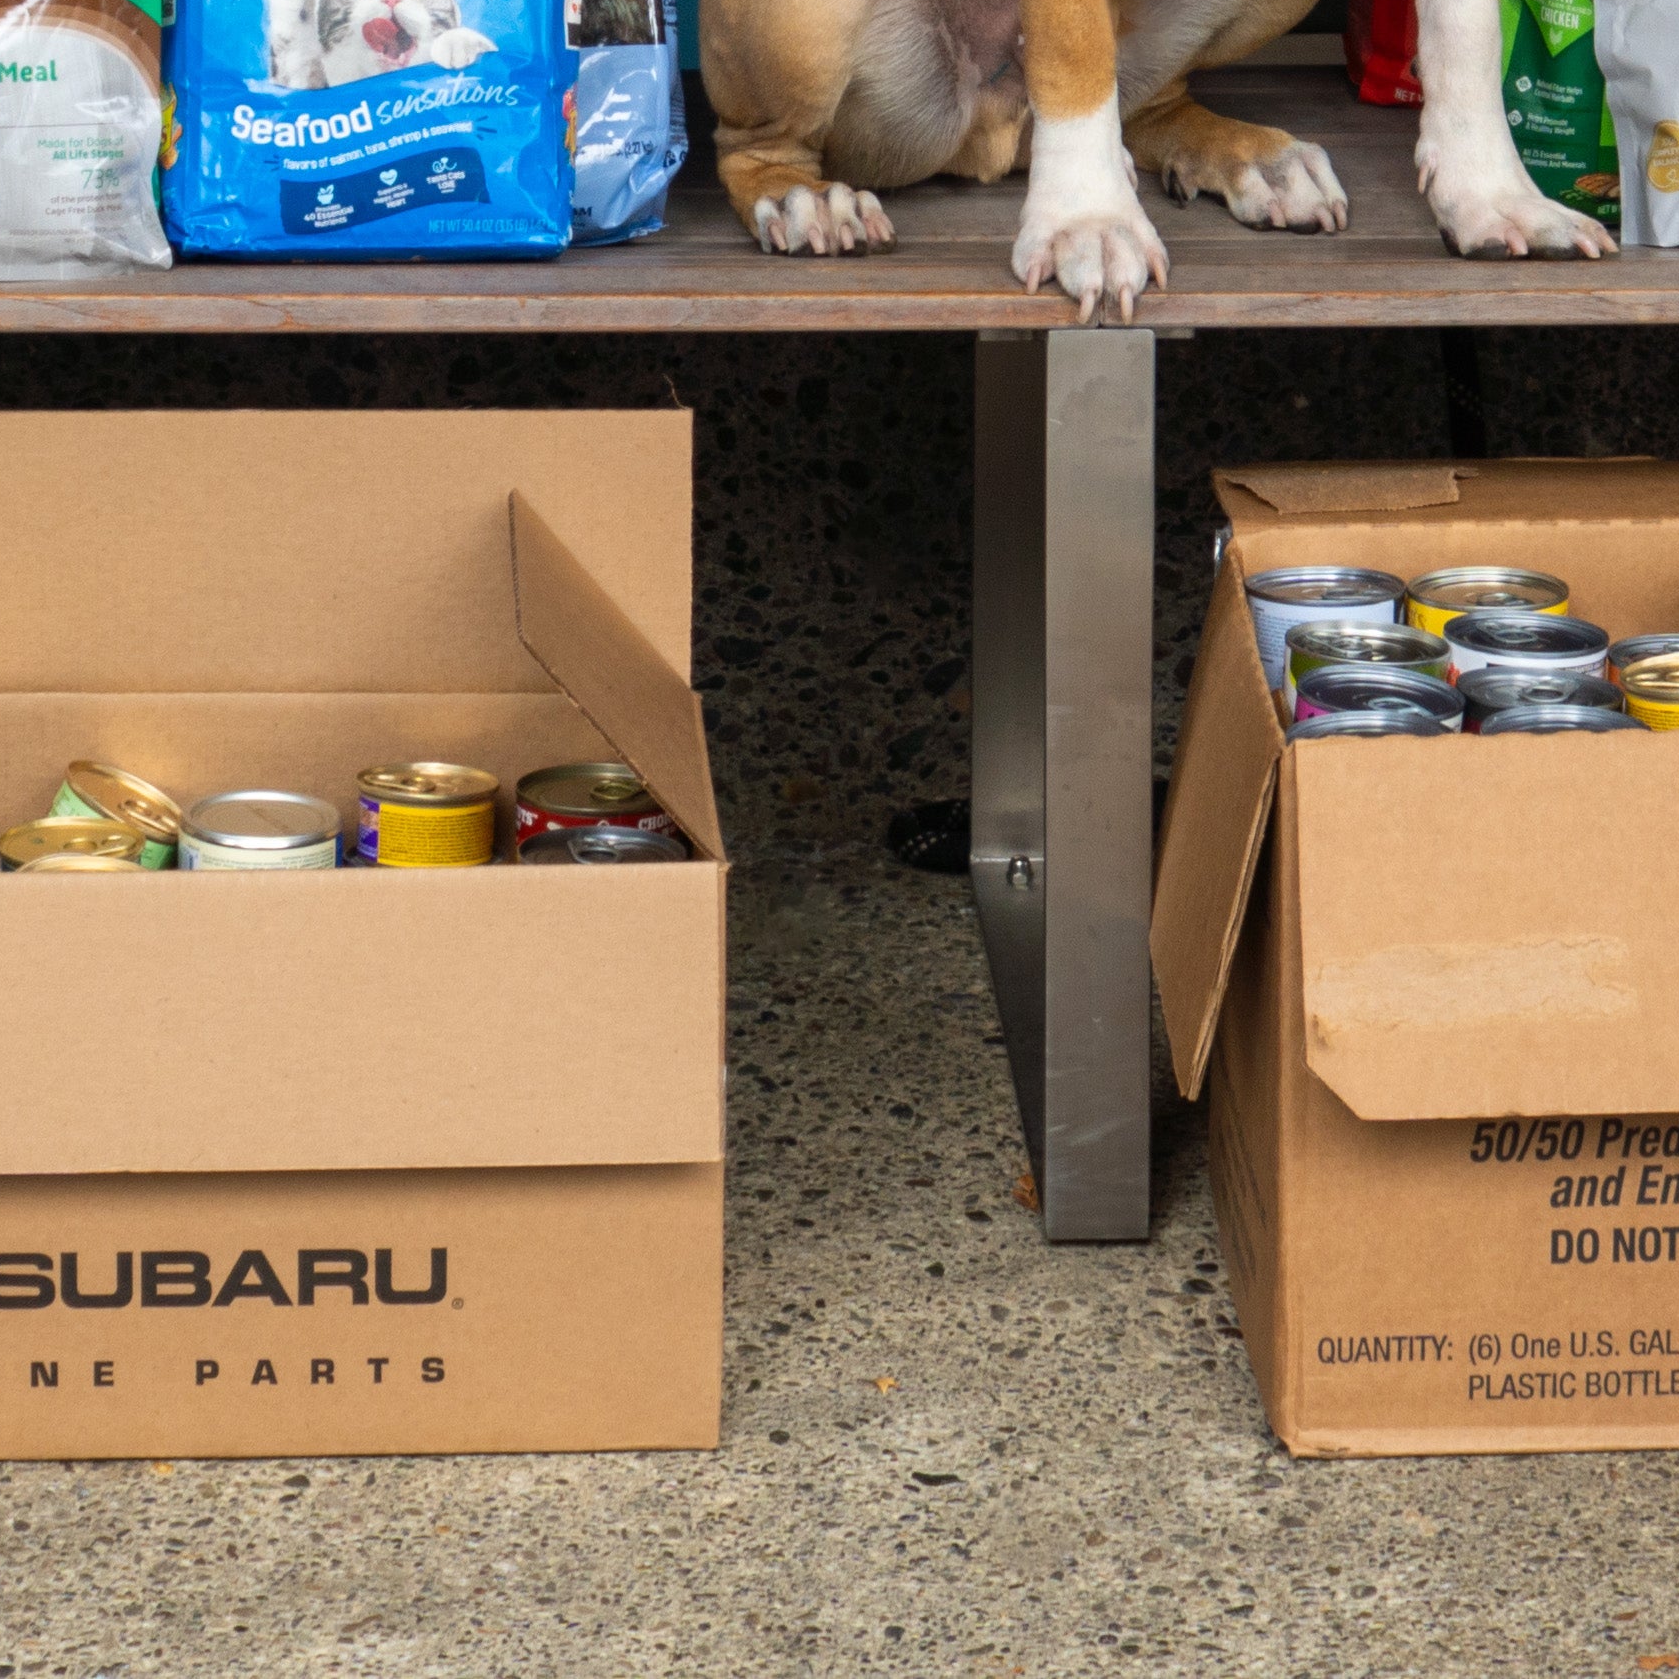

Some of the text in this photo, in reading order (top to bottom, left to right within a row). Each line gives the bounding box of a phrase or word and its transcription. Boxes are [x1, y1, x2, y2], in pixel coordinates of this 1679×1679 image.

[232, 72, 520, 148] Seafood sensations
[1469, 1119, 1583, 1163] 50/50
[1549, 1168, 1622, 1209] and
[1550, 1229, 1600, 1266] DO
[1317, 1335, 1454, 1365] QUANTITY:
[1468, 1334, 1502, 1366] (6)
[1511, 1334, 1562, 1361] One
[1569, 1331, 1621, 1358] U.S.
[195, 1355, 448, 1387] PARTS
[1468, 1372, 1576, 1401] PLASTIC
